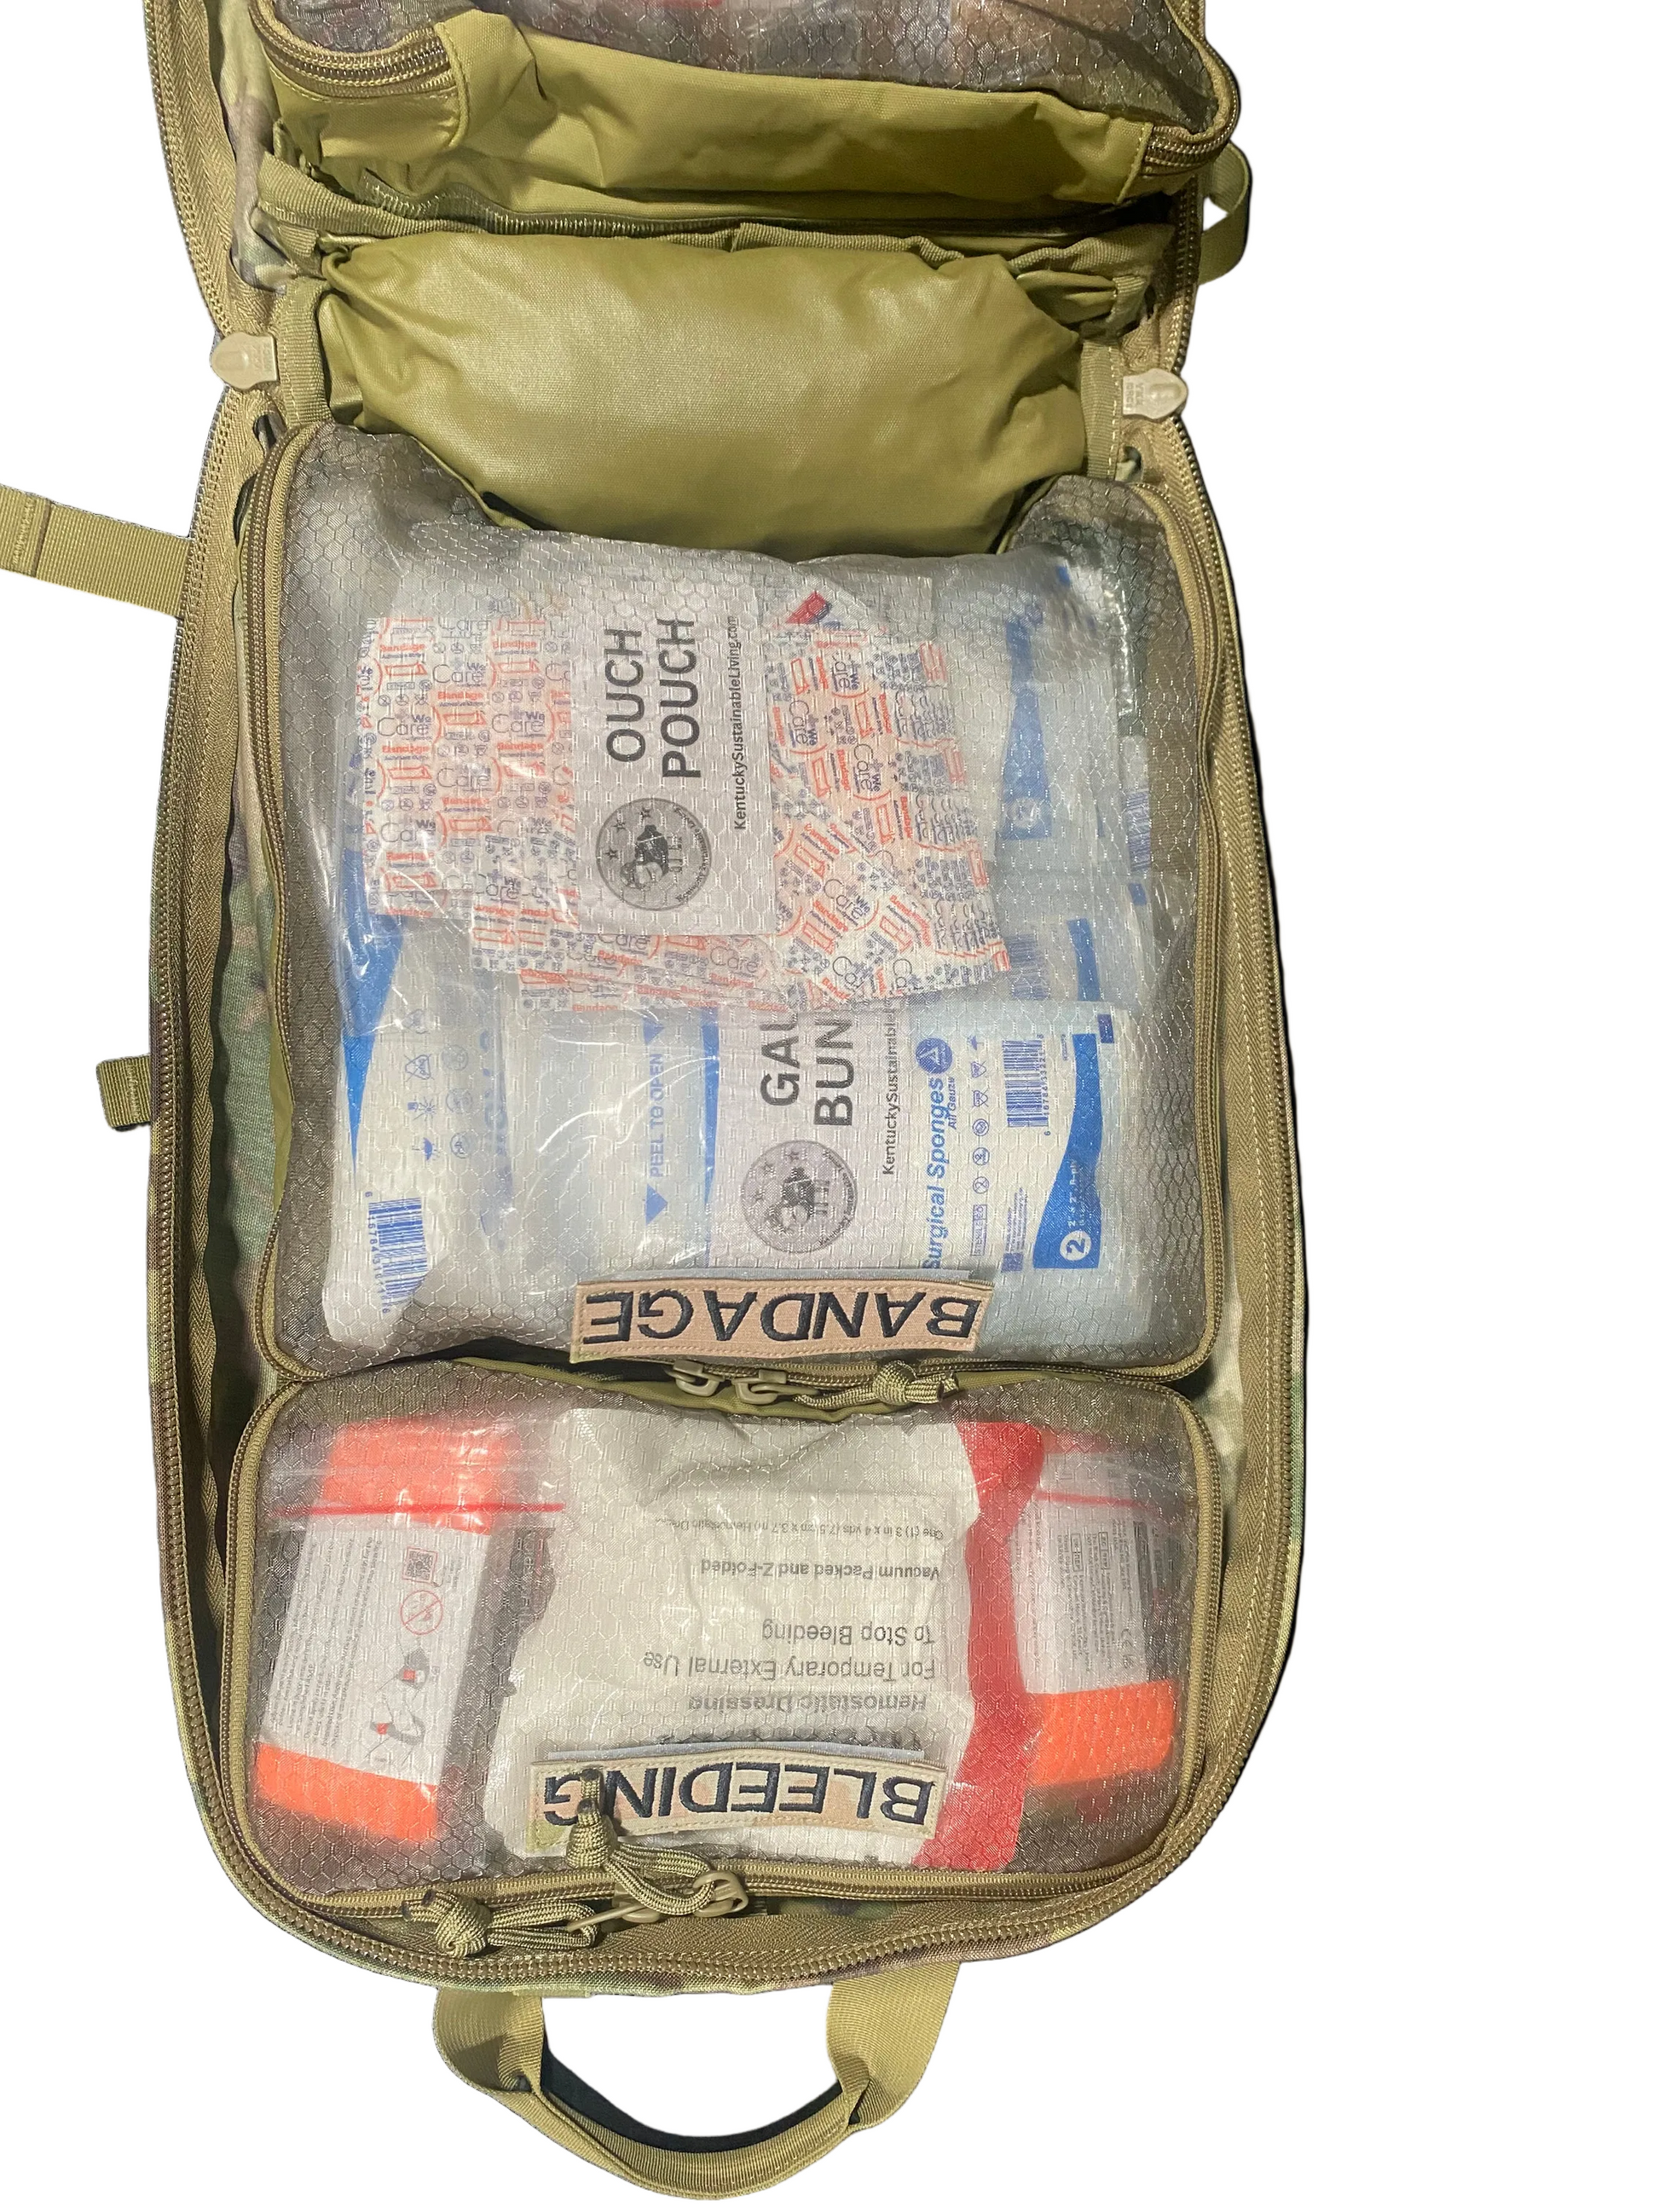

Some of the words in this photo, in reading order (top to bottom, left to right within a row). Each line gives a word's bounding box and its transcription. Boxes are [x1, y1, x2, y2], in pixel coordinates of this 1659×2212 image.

[432, 664, 485, 684] Care
[604, 629, 645, 762] OUCH
[656, 618, 702, 778] POUCH
[377, 717, 430, 736] Care
[491, 713, 544, 733] Care
[728, 615, 748, 829] KentuckySustainableLiving.com
[789, 700, 809, 744] Care
[853, 743, 873, 791] Care
[824, 879, 864, 921] Care
[649, 1053, 664, 1101] OPEN
[813, 1019, 853, 1126] BUN
[649, 1111, 664, 1131] TO
[927, 1077, 950, 1180] Sponges
[649, 1137, 664, 1178] PEEL
[923, 1186, 949, 1269] Surgical
[1066, 1238, 1085, 1255] 2
[583, 1289, 981, 1345] BANDAGE
[772, 1522, 790, 1533] 3.7
[702, 1558, 773, 1577] Z-Folded
[778, 1561, 807, 1575] and
[814, 1562, 872, 1580] Packed
[880, 1565, 939, 1580] Vacuum
[763, 1619, 852, 1645] Bleeding
[860, 1621, 908, 1646] Stop
[914, 1625, 935, 1645] To
[644, 1650, 679, 1677] Use
[688, 1655, 777, 1681] External
[786, 1655, 897, 1682] Temporary
[902, 1658, 936, 1679] For
[688, 1693, 794, 1714] Dressing
[799, 1694, 927, 1713] Hemostatic
[543, 1761, 935, 1826] BLEEDING
